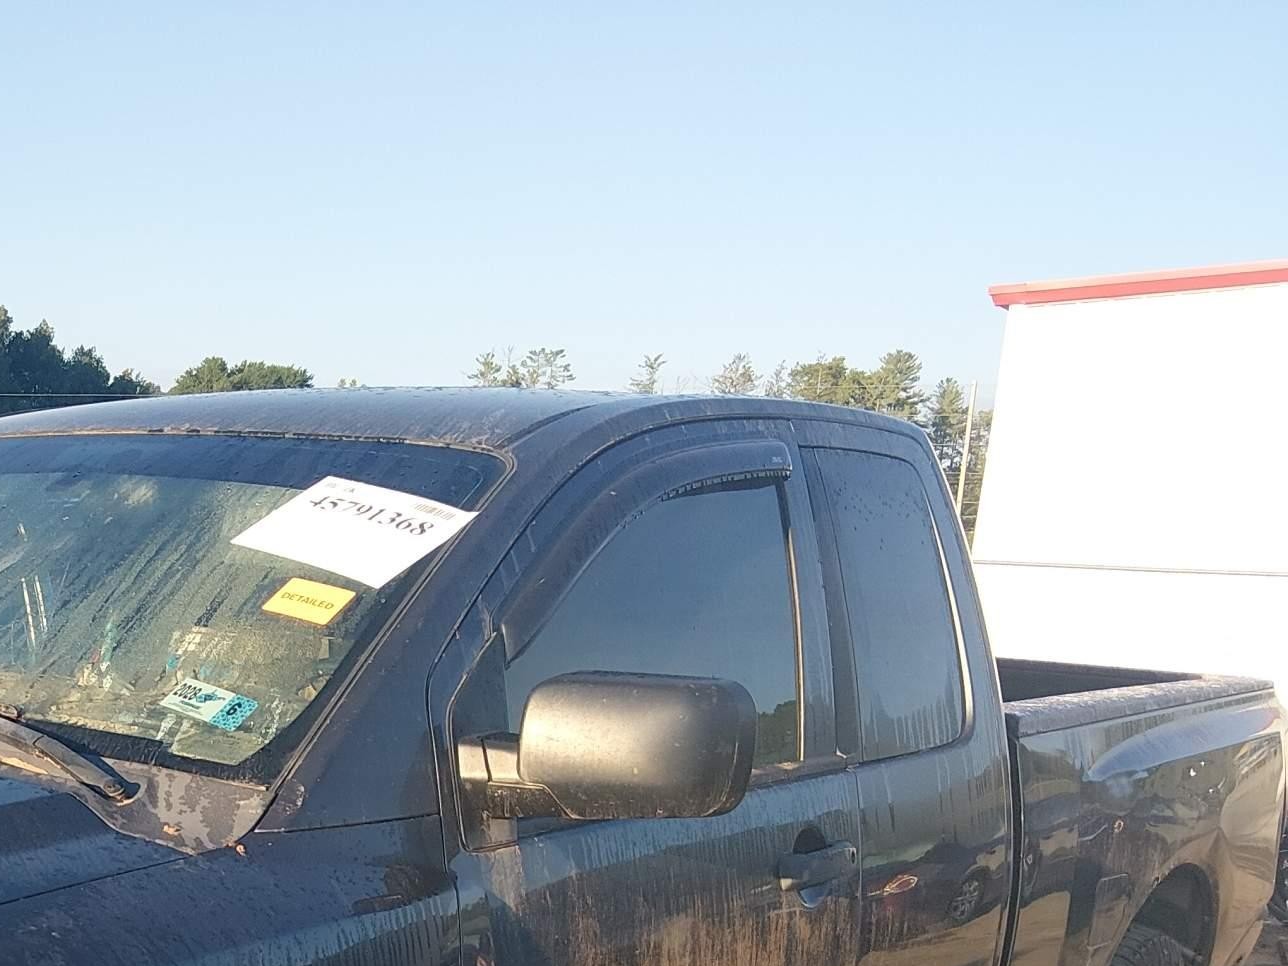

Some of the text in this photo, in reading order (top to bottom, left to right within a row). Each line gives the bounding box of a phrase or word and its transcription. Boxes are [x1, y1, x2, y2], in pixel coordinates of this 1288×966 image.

[310, 495, 434, 536] 45791368
[280, 591, 334, 610] DETAILED
[226, 701, 242, 716] 6
